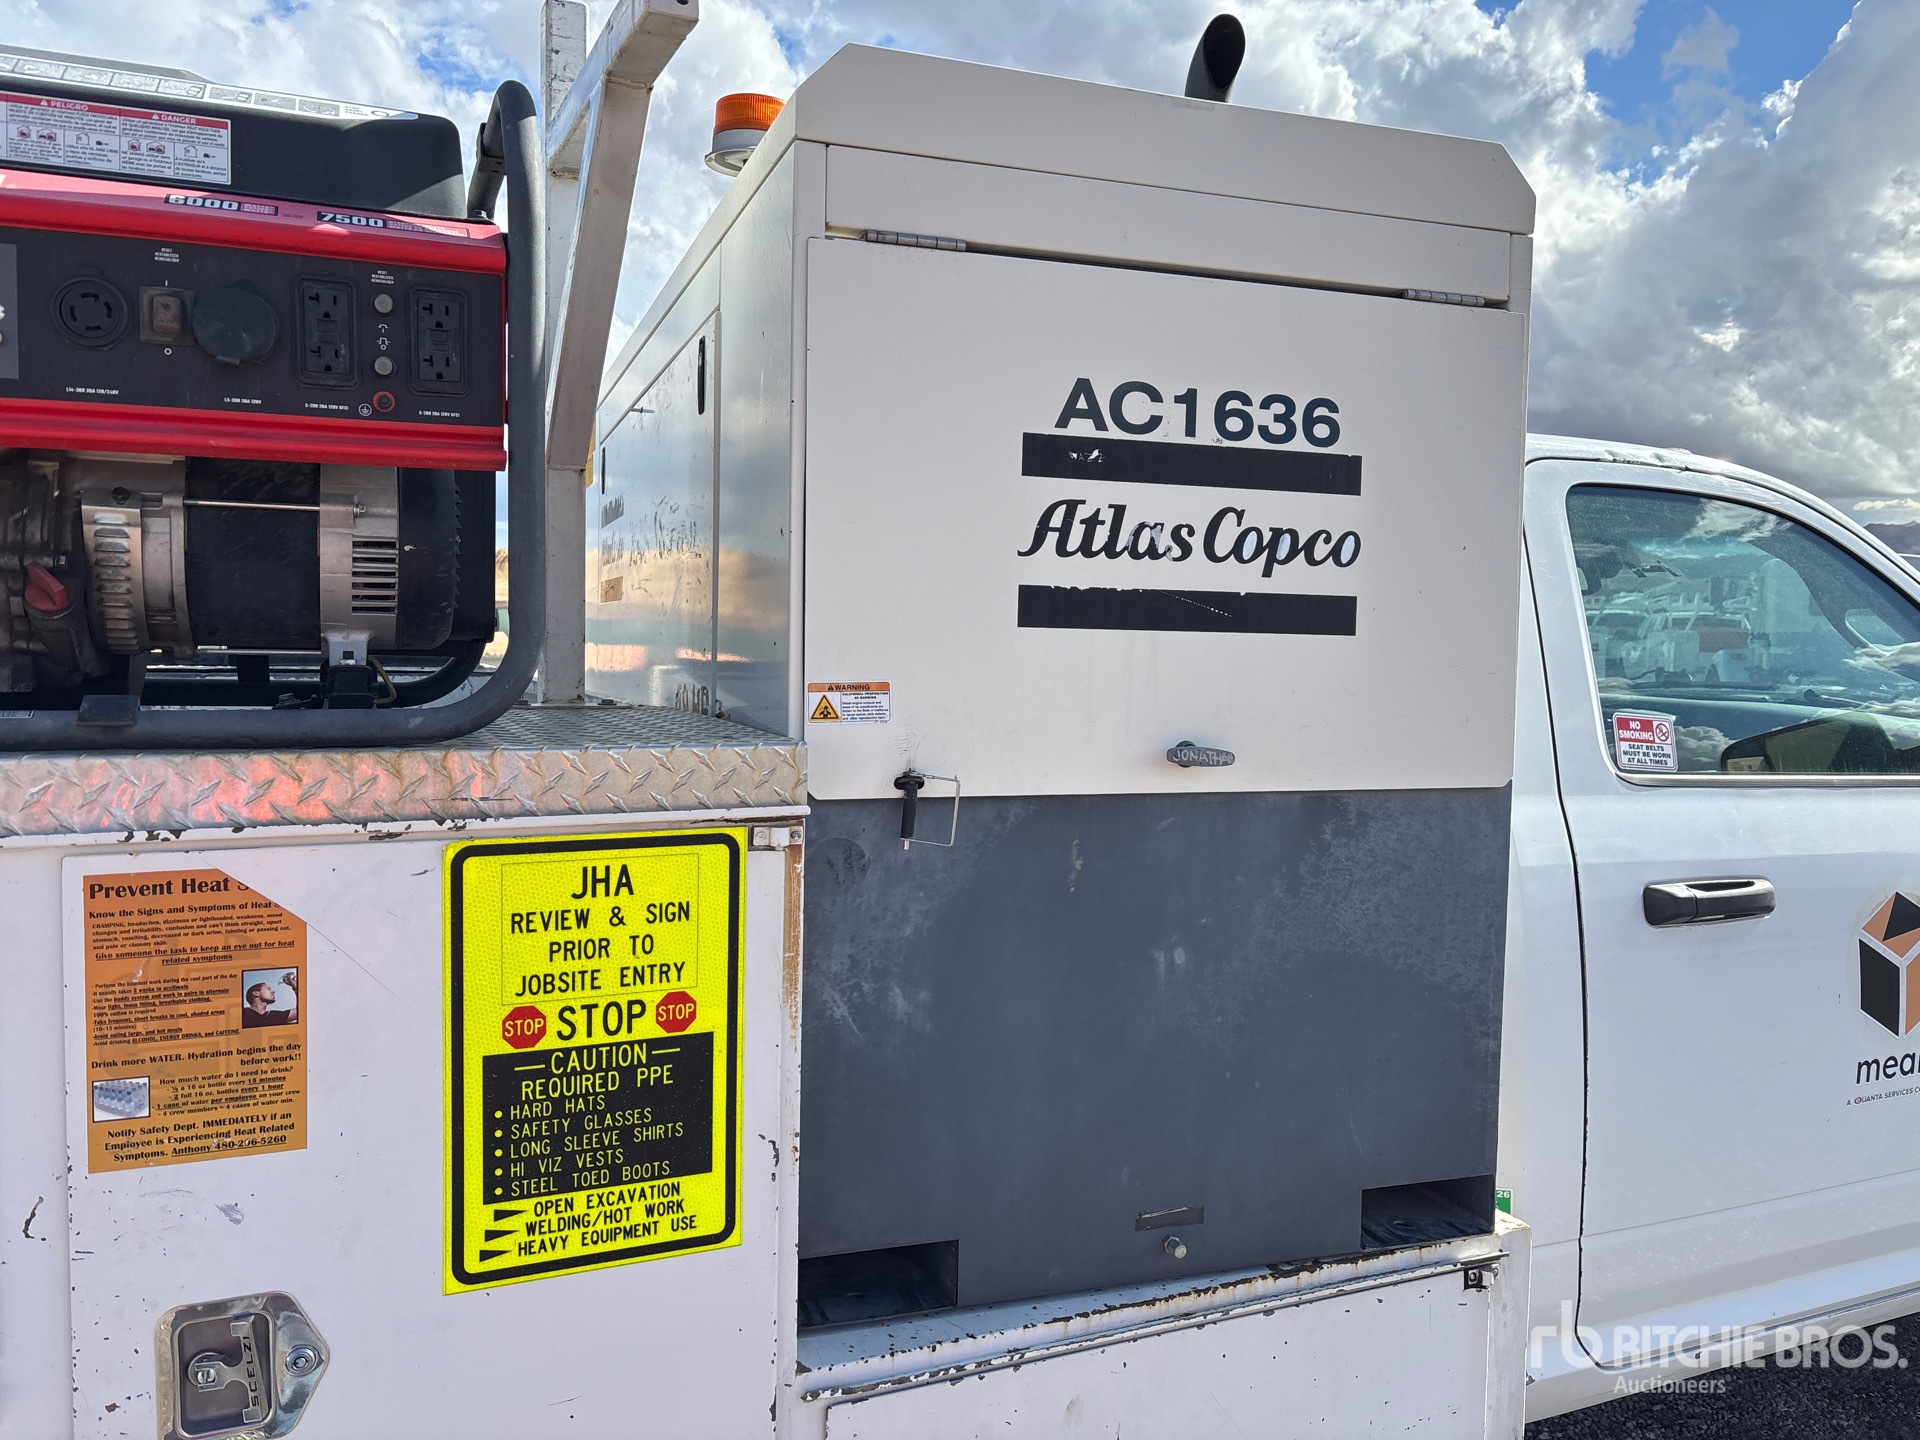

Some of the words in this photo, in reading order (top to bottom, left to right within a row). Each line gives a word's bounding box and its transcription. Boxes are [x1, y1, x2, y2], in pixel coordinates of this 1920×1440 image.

[50, 100, 88, 111] PELIGRO
[161, 114, 196, 124] DANGER
[168, 194, 239, 211] 6000
[320, 212, 383, 228] 7500
[1054, 378, 1340, 448] AC1636
[1017, 499, 1196, 562] Atlas
[1203, 507, 1361, 578] Copco
[1619, 730, 1654, 740] SMOKING
[1629, 720, 1641, 729] NO
[89, 880, 173, 899] Prevent
[181, 877, 230, 893] Heat
[571, 864, 634, 899] JHA
[89, 911, 116, 919] Know
[119, 909, 134, 917] the
[137, 907, 164, 917] Signs
[167, 906, 185, 914] and
[188, 904, 236, 913] Symptoms
[239, 902, 248, 910] of
[251, 901, 272, 909] Heat
[511, 908, 590, 934] REVIEW
[609, 906, 626, 927] &
[646, 901, 690, 924] SIGN
[95, 952, 113, 960] Give
[161, 956, 190, 965] related
[192, 954, 233, 963] symptoms
[549, 938, 610, 962] PRIOR
[629, 934, 654, 955] TO
[515, 969, 601, 997] JOBSITE
[619, 962, 685, 987] ENTRY
[504, 1018, 545, 1037] STOP
[556, 999, 646, 1041] STOP
[657, 1003, 695, 1022] STOP
[91, 1059, 118, 1069] Drink
[121, 1058, 146, 1066] more
[149, 1053, 184, 1064] WATER.
[188, 1049, 233, 1060] Hydration
[236, 1046, 266, 1056] begins
[269, 1044, 283, 1052] the
[286, 1043, 302, 1051] day
[240, 1057, 270, 1066] before
[272, 1053, 302, 1062] work!!
[551, 1043, 647, 1075] CAUTION
[1856, 1052, 1920, 1084] mea
[178, 1075, 199, 1083] much
[201, 1072, 222, 1080] water
[270, 1066, 293, 1074] drink?
[259, 1075, 286, 1083] minutes
[522, 1071, 620, 1101] REQUIRED
[636, 1064, 674, 1088] PPE
[510, 1101, 552, 1120] HARD
[565, 1095, 605, 1114] HATS
[1854, 1094, 1883, 1104] QUANTA
[1884, 1088, 1913, 1099] SERVICES
[187, 1106, 218, 1114] members
[511, 1118, 571, 1139] SAFETY
[584, 1108, 652, 1131] GLASSES
[105, 1139, 152, 1151] Employee
[167, 1130, 231, 1144] Experiencing
[234, 1128, 256, 1136] Heat
[259, 1122, 295, 1133] Related
[107, 1129, 137, 1138] Notify
[140, 1125, 170, 1135] Safety
[173, 1122, 199, 1132] Dept.
[203, 1114, 268, 1128] IMMEDIATELY
[113, 1150, 168, 1162] Symptoms.
[171, 1145, 211, 1155] Anthony
[510, 1139, 550, 1159] LONG
[564, 1131, 621, 1151] SLEEVE
[633, 1122, 684, 1143] SHIRTS
[510, 1162, 525, 1177] HI
[538, 1157, 562, 1174] VIZ
[575, 1149, 624, 1169] VESTS
[511, 1177, 558, 1197] STEEL
[572, 1169, 609, 1188] TOED
[622, 1160, 670, 1180] BOOTS
[533, 1197, 574, 1217] OPEN
[586, 1182, 680, 1207] EXCAVATION
[526, 1206, 632, 1237] WELDING/HOT
[645, 1199, 684, 1217] WORK
[518, 1236, 569, 1257] HEAVY
[581, 1221, 659, 1247] EQUIPMENT
[670, 1215, 697, 1232] USE
[242, 1336, 260, 1407] SCELZI
